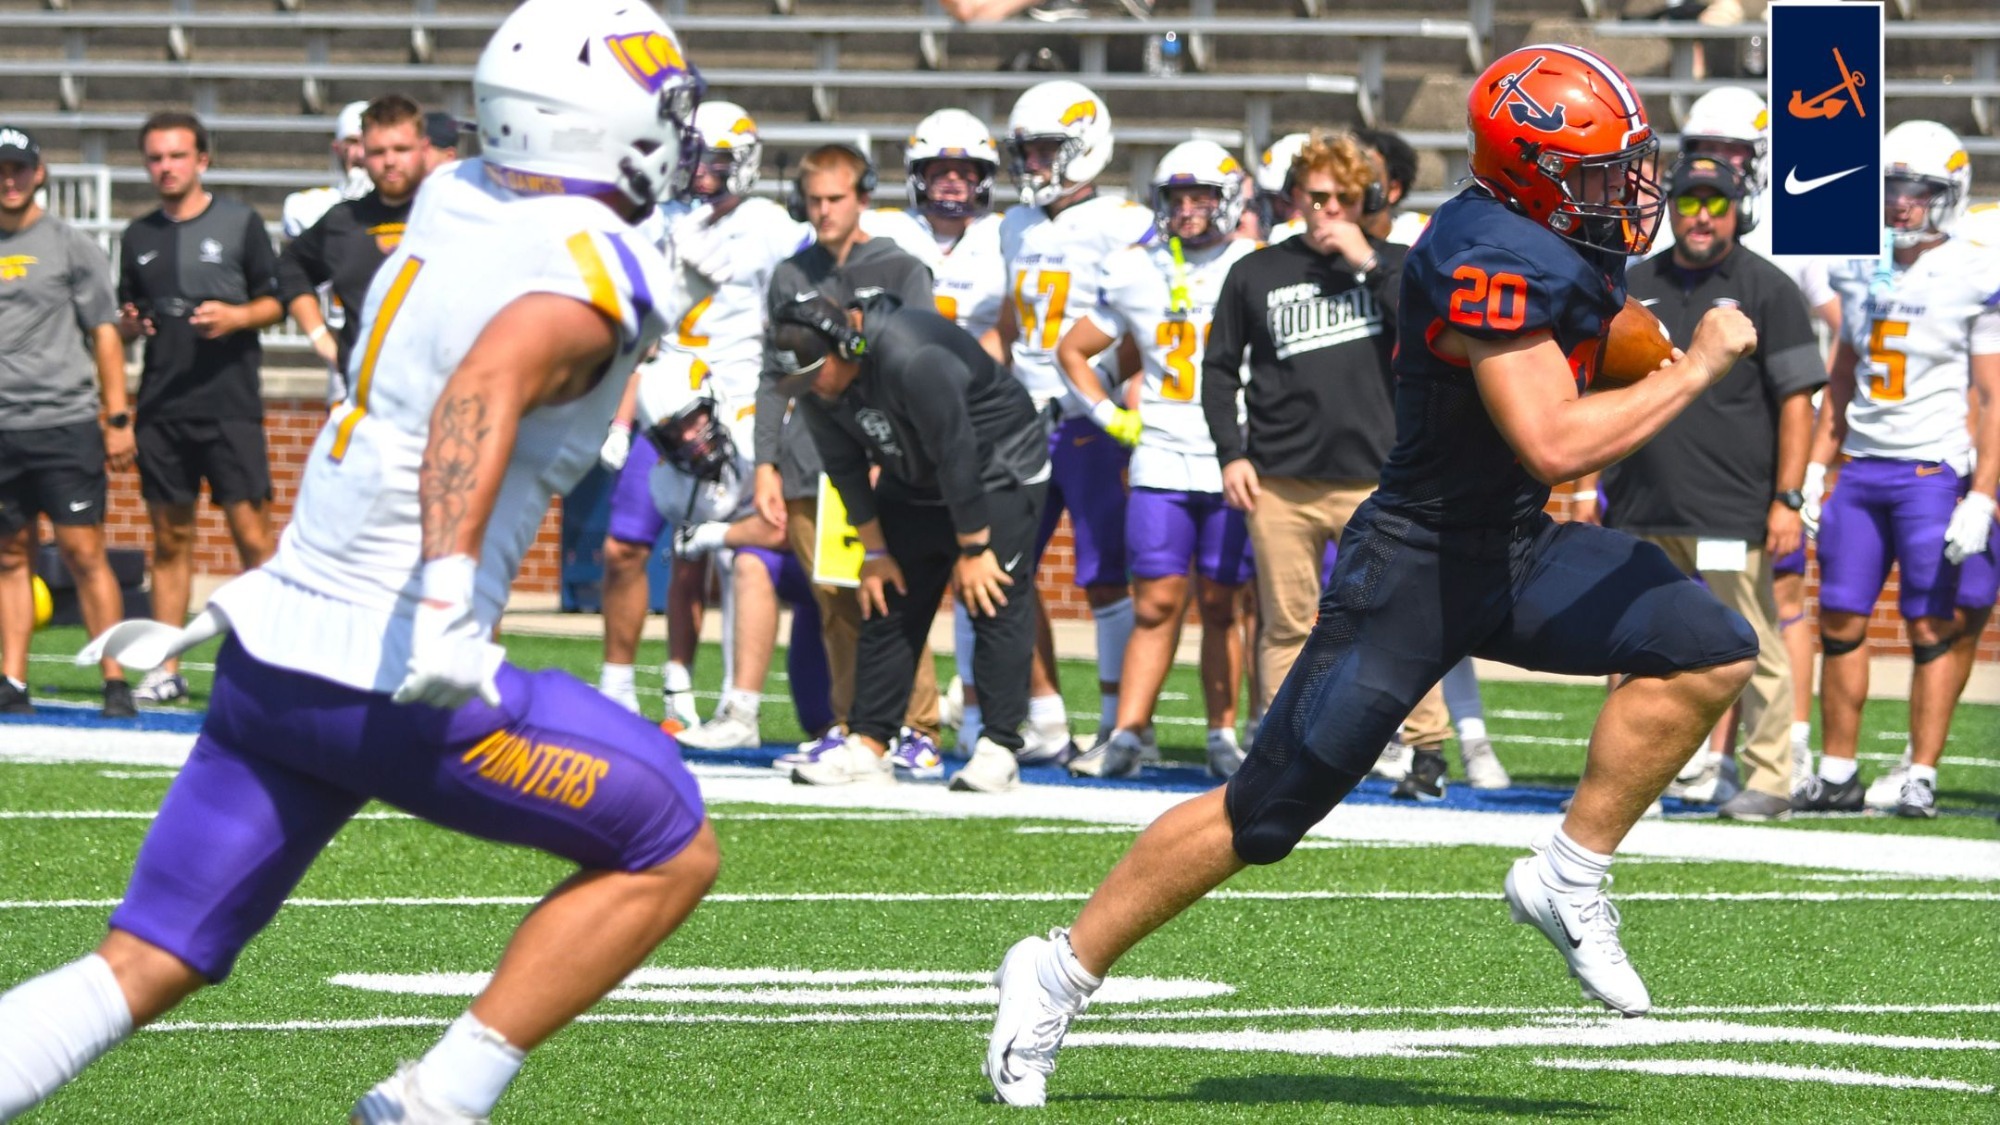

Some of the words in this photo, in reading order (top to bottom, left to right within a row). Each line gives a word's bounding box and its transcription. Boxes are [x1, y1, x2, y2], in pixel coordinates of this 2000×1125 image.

[1013, 269, 1071, 350] 47
[1266, 286, 1384, 348] FOOTBALL
[1448, 264, 1528, 331] 20
[327, 253, 425, 465] 1
[1155, 320, 1214, 404] 3
[1868, 319, 1910, 401] 5
[461, 728, 611, 809] POINTERS
